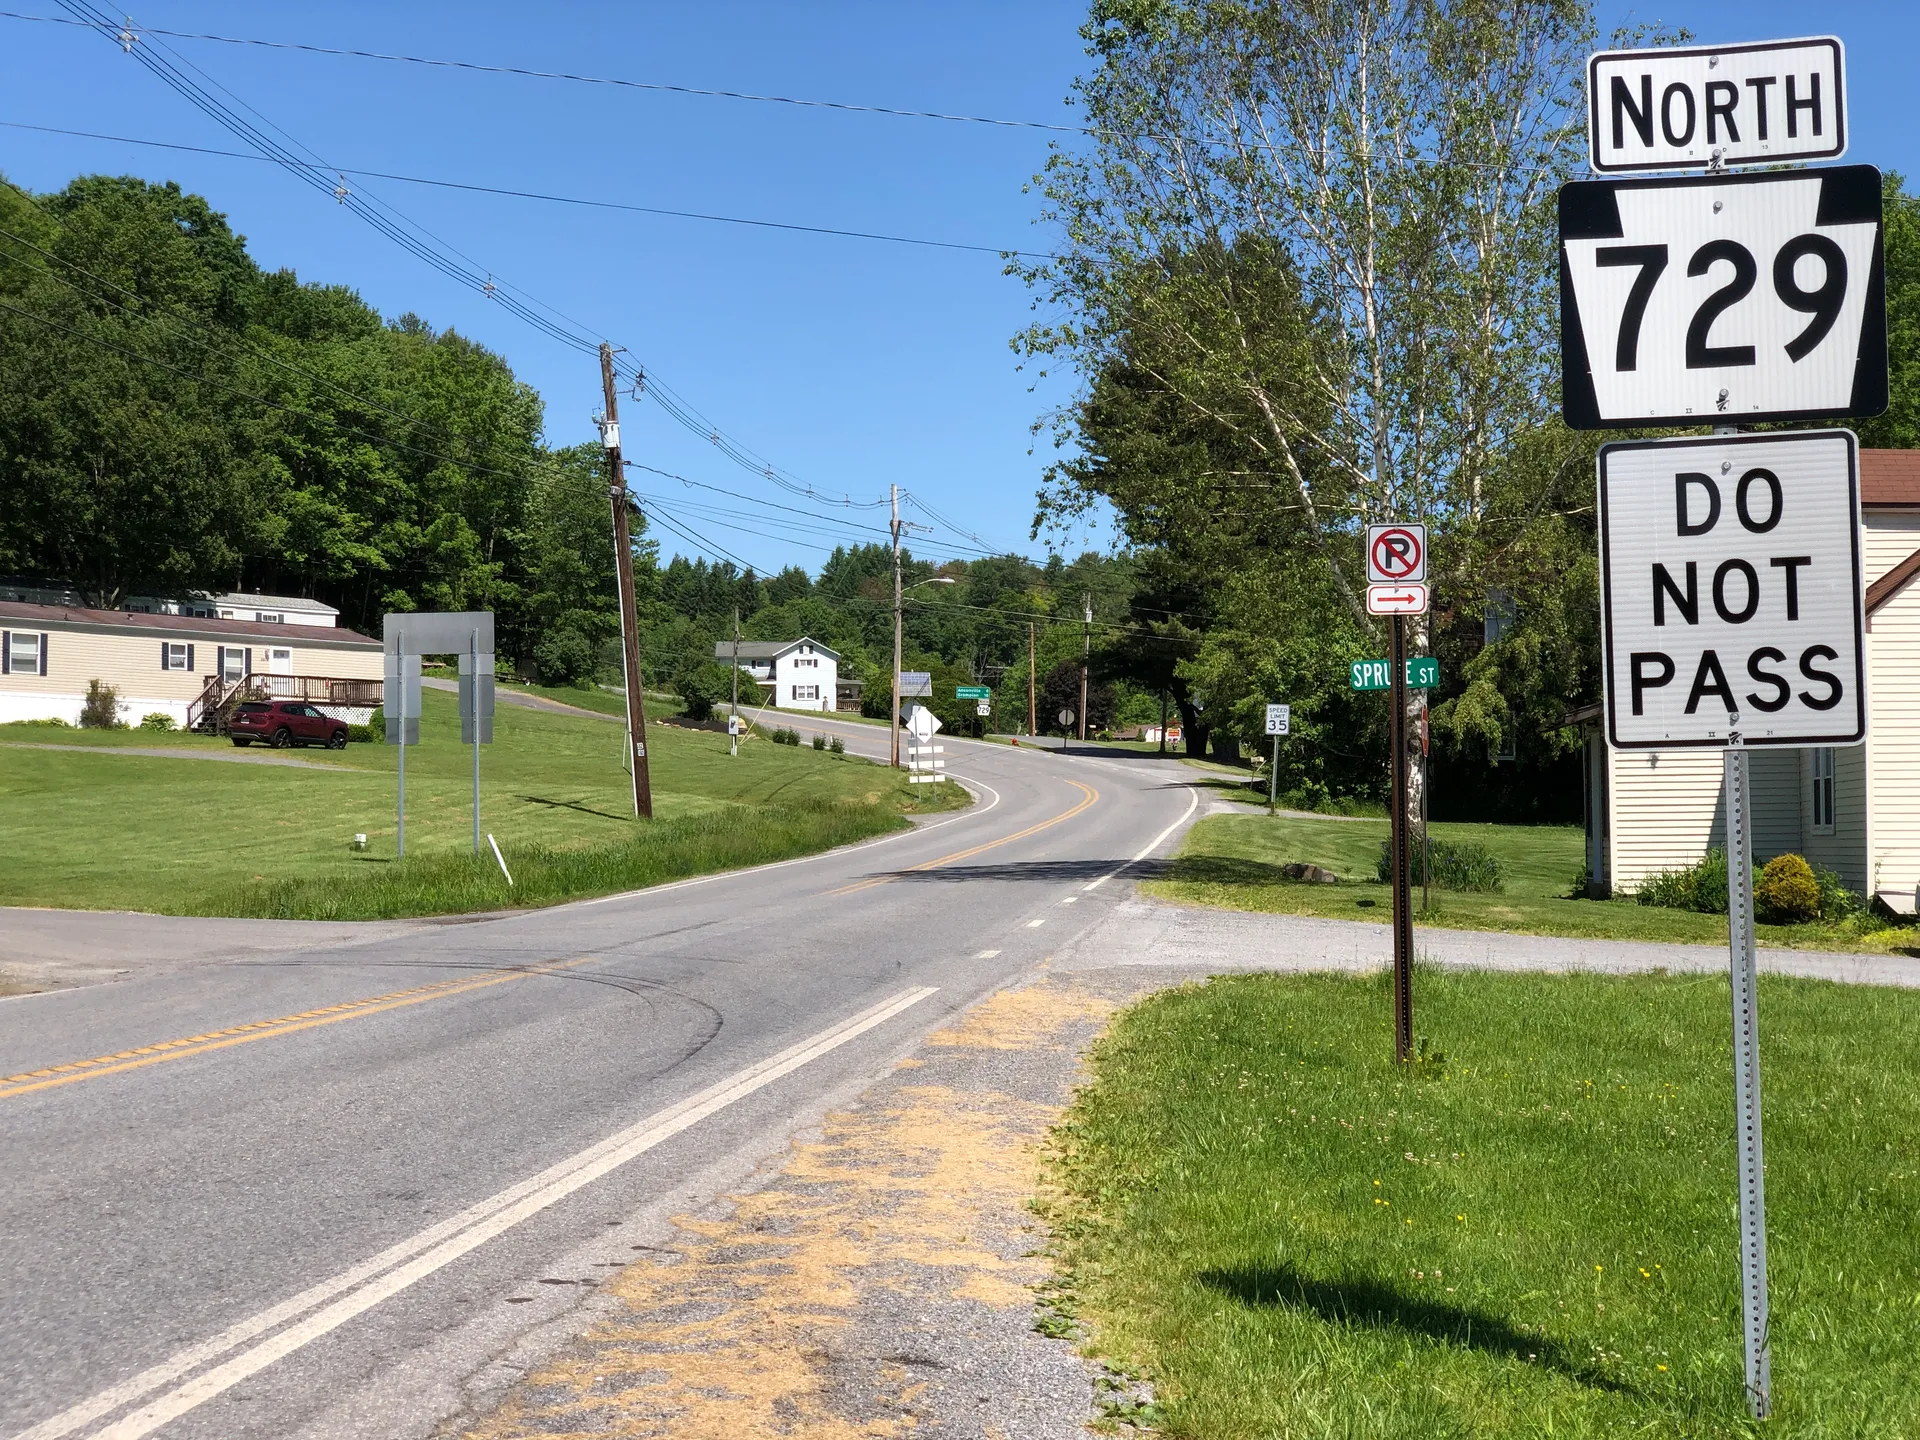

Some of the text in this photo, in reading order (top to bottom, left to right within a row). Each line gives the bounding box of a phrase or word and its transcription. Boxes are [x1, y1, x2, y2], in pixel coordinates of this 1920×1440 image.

[1611, 73, 1822, 149] NORTH
[1596, 233, 1847, 372] 729
[1675, 468, 1783, 537] DO
[1652, 556, 1812, 626] NOT
[1353, 661, 1435, 687] SPRUE ST
[1630, 644, 1843, 716] PASS
[1268, 720, 1287, 731] 35
